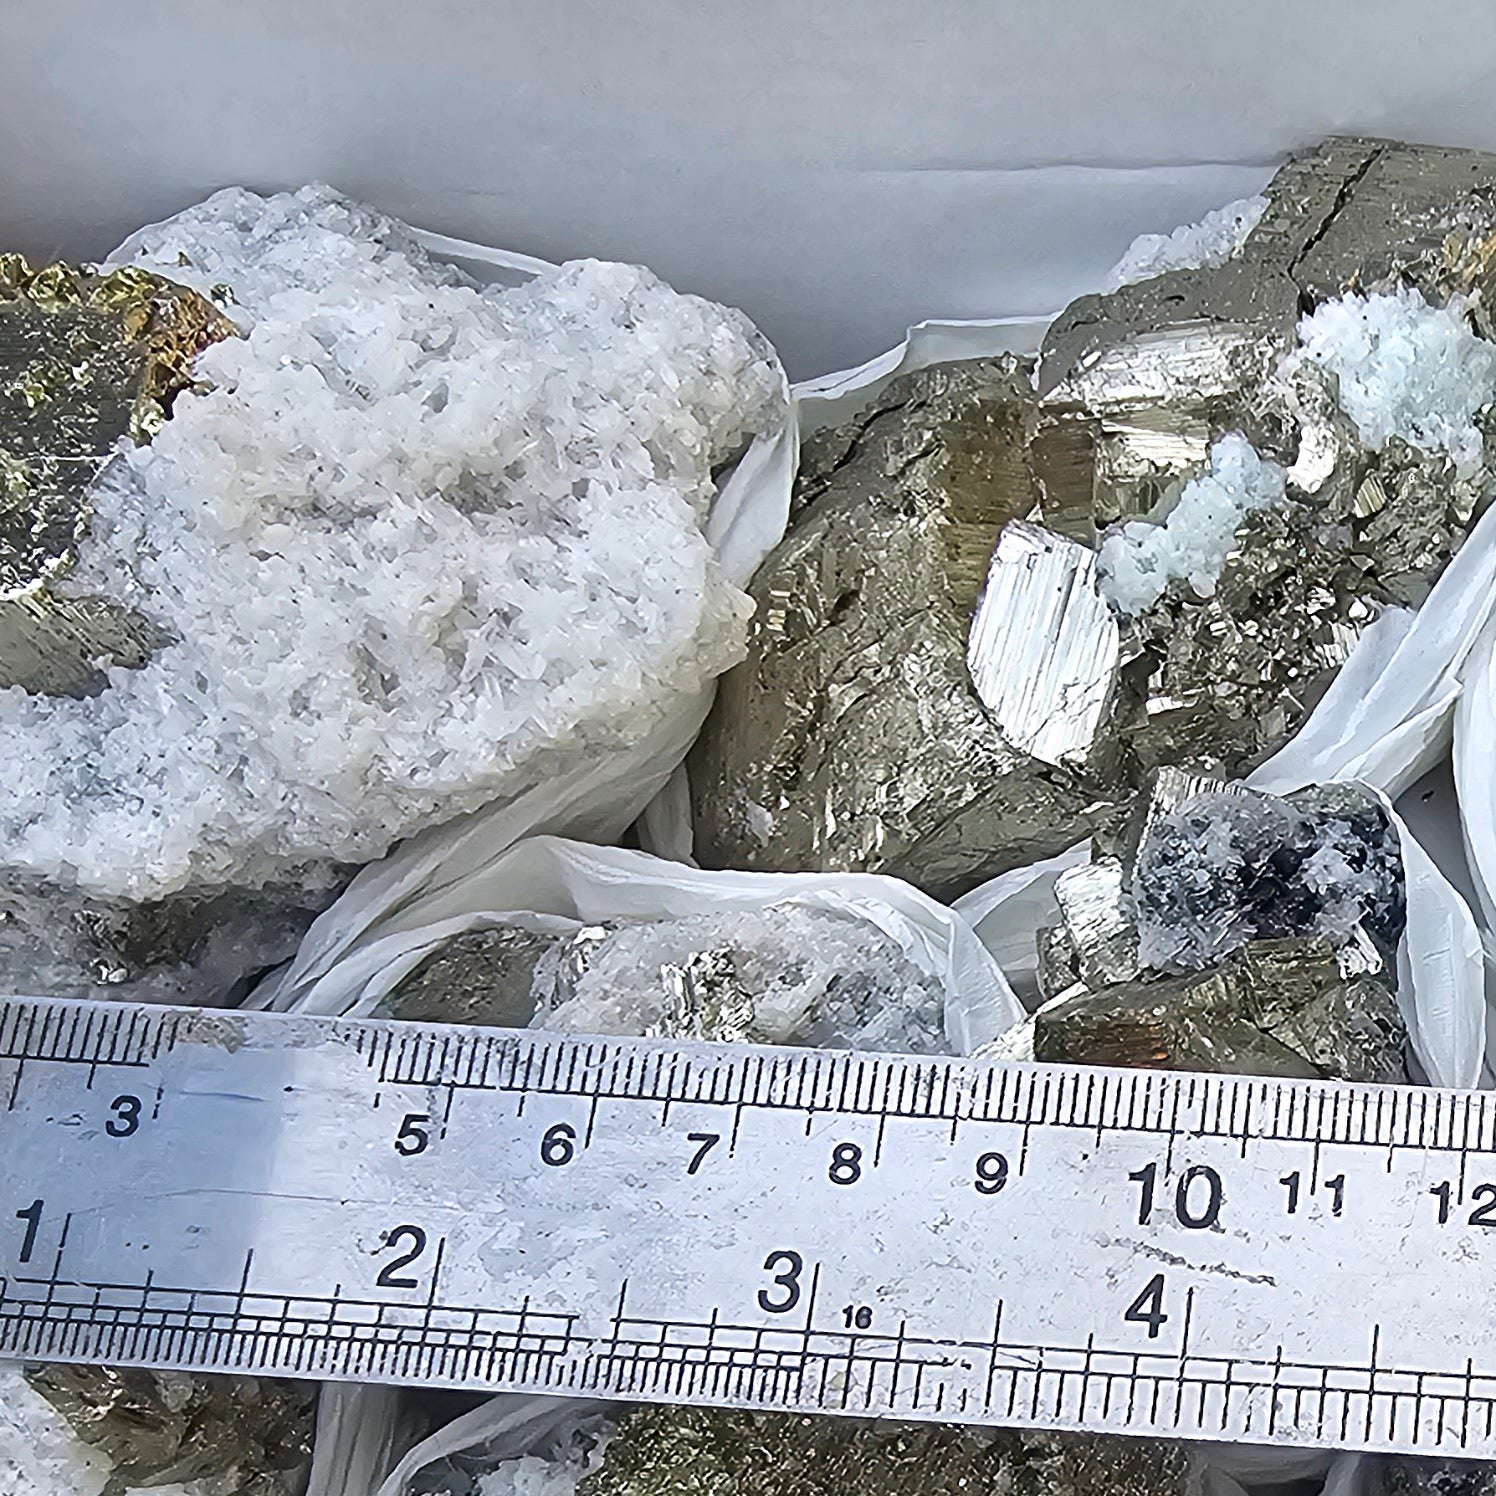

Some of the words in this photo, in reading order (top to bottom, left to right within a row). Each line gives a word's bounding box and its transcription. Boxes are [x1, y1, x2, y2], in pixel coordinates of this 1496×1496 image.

[105, 1095, 142, 1138] 3
[394, 1114, 430, 1156] 5
[540, 1122, 576, 1166] 6
[687, 1133, 721, 1175] 7
[828, 1143, 862, 1185] 8
[975, 1152, 1009, 1194] 9
[1128, 1162, 1223, 1230] 10
[1279, 1171, 1346, 1217] 11
[16, 1199, 45, 1263] 1
[376, 1225, 427, 1288] 2
[758, 1251, 802, 1313] 3
[1125, 1274, 1168, 1338] 4
[842, 1305, 873, 1329] 16
